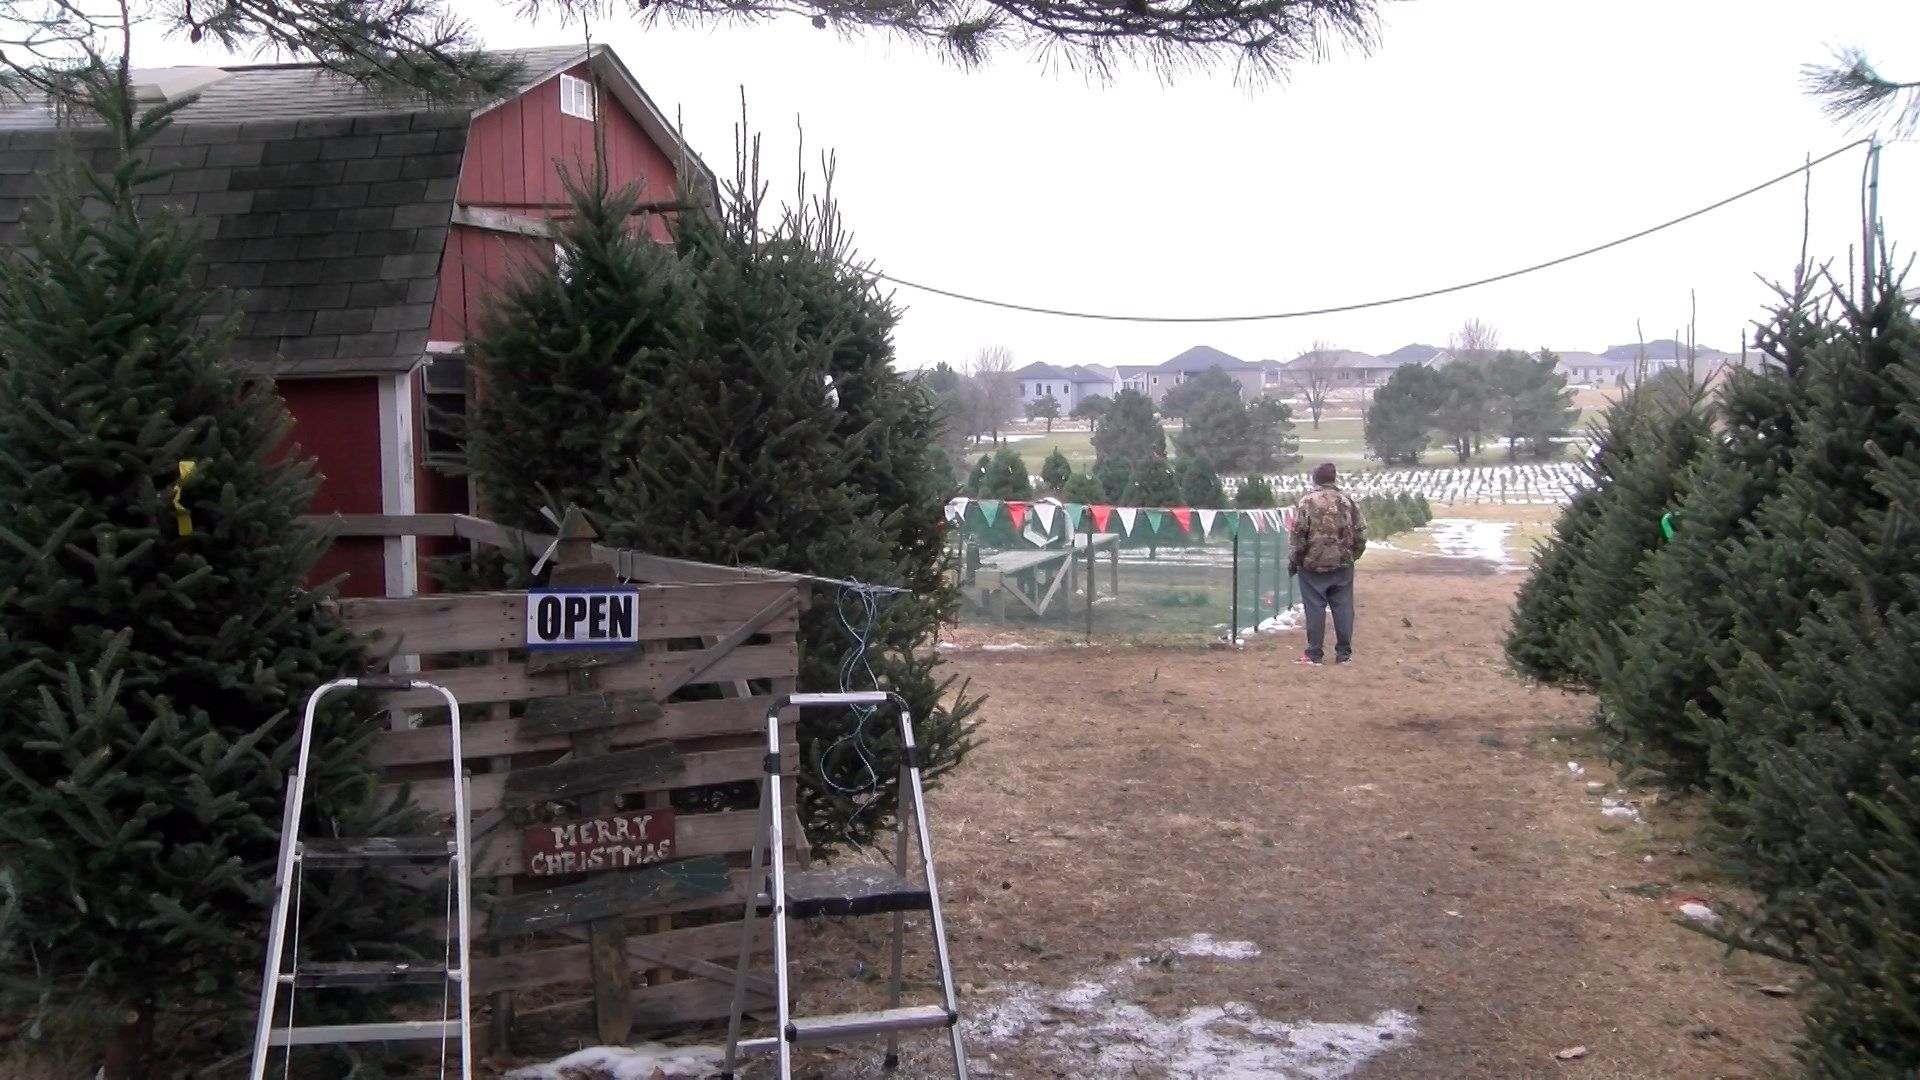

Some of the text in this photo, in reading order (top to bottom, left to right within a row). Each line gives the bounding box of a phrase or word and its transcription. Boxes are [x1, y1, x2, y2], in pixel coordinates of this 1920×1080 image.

[537, 595, 632, 641] OPEN
[551, 815, 652, 849] MERRY
[531, 839, 670, 875] CHRISTMAS
